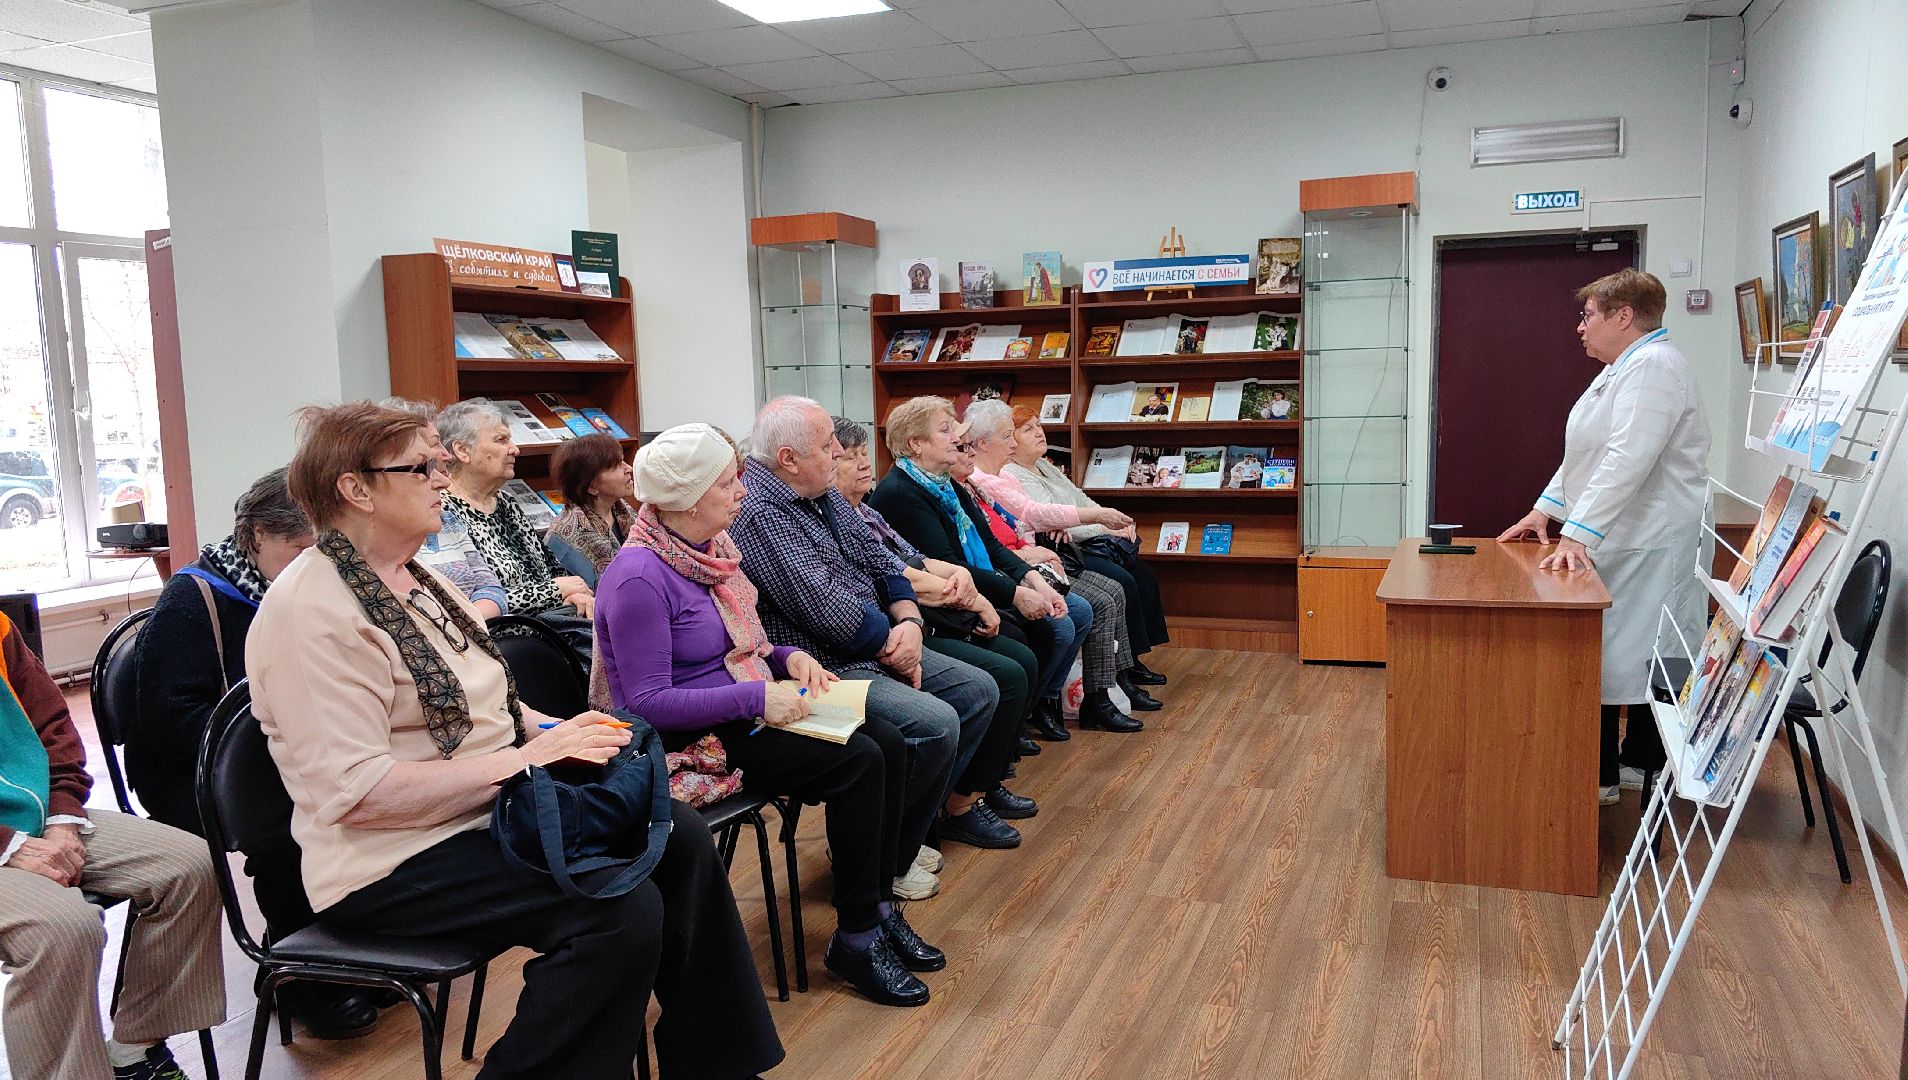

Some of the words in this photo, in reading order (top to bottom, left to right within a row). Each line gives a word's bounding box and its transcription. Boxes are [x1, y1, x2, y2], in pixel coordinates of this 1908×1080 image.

[1517, 193, 1577, 209] ВЫХОД
[441, 244, 524, 264] ЩЁЛКОВСКИЙ
[525, 255, 552, 268] КРАЙ
[459, 260, 509, 278] событиях
[513, 270, 520, 279] и
[523, 268, 556, 285] судьбах
[1113, 269, 1130, 285] ВСЁ
[1132, 268, 1195, 283] НАЧИНАЕТСЯ
[1197, 268, 1204, 280] С
[1206, 266, 1240, 280] СЕМЬИ
